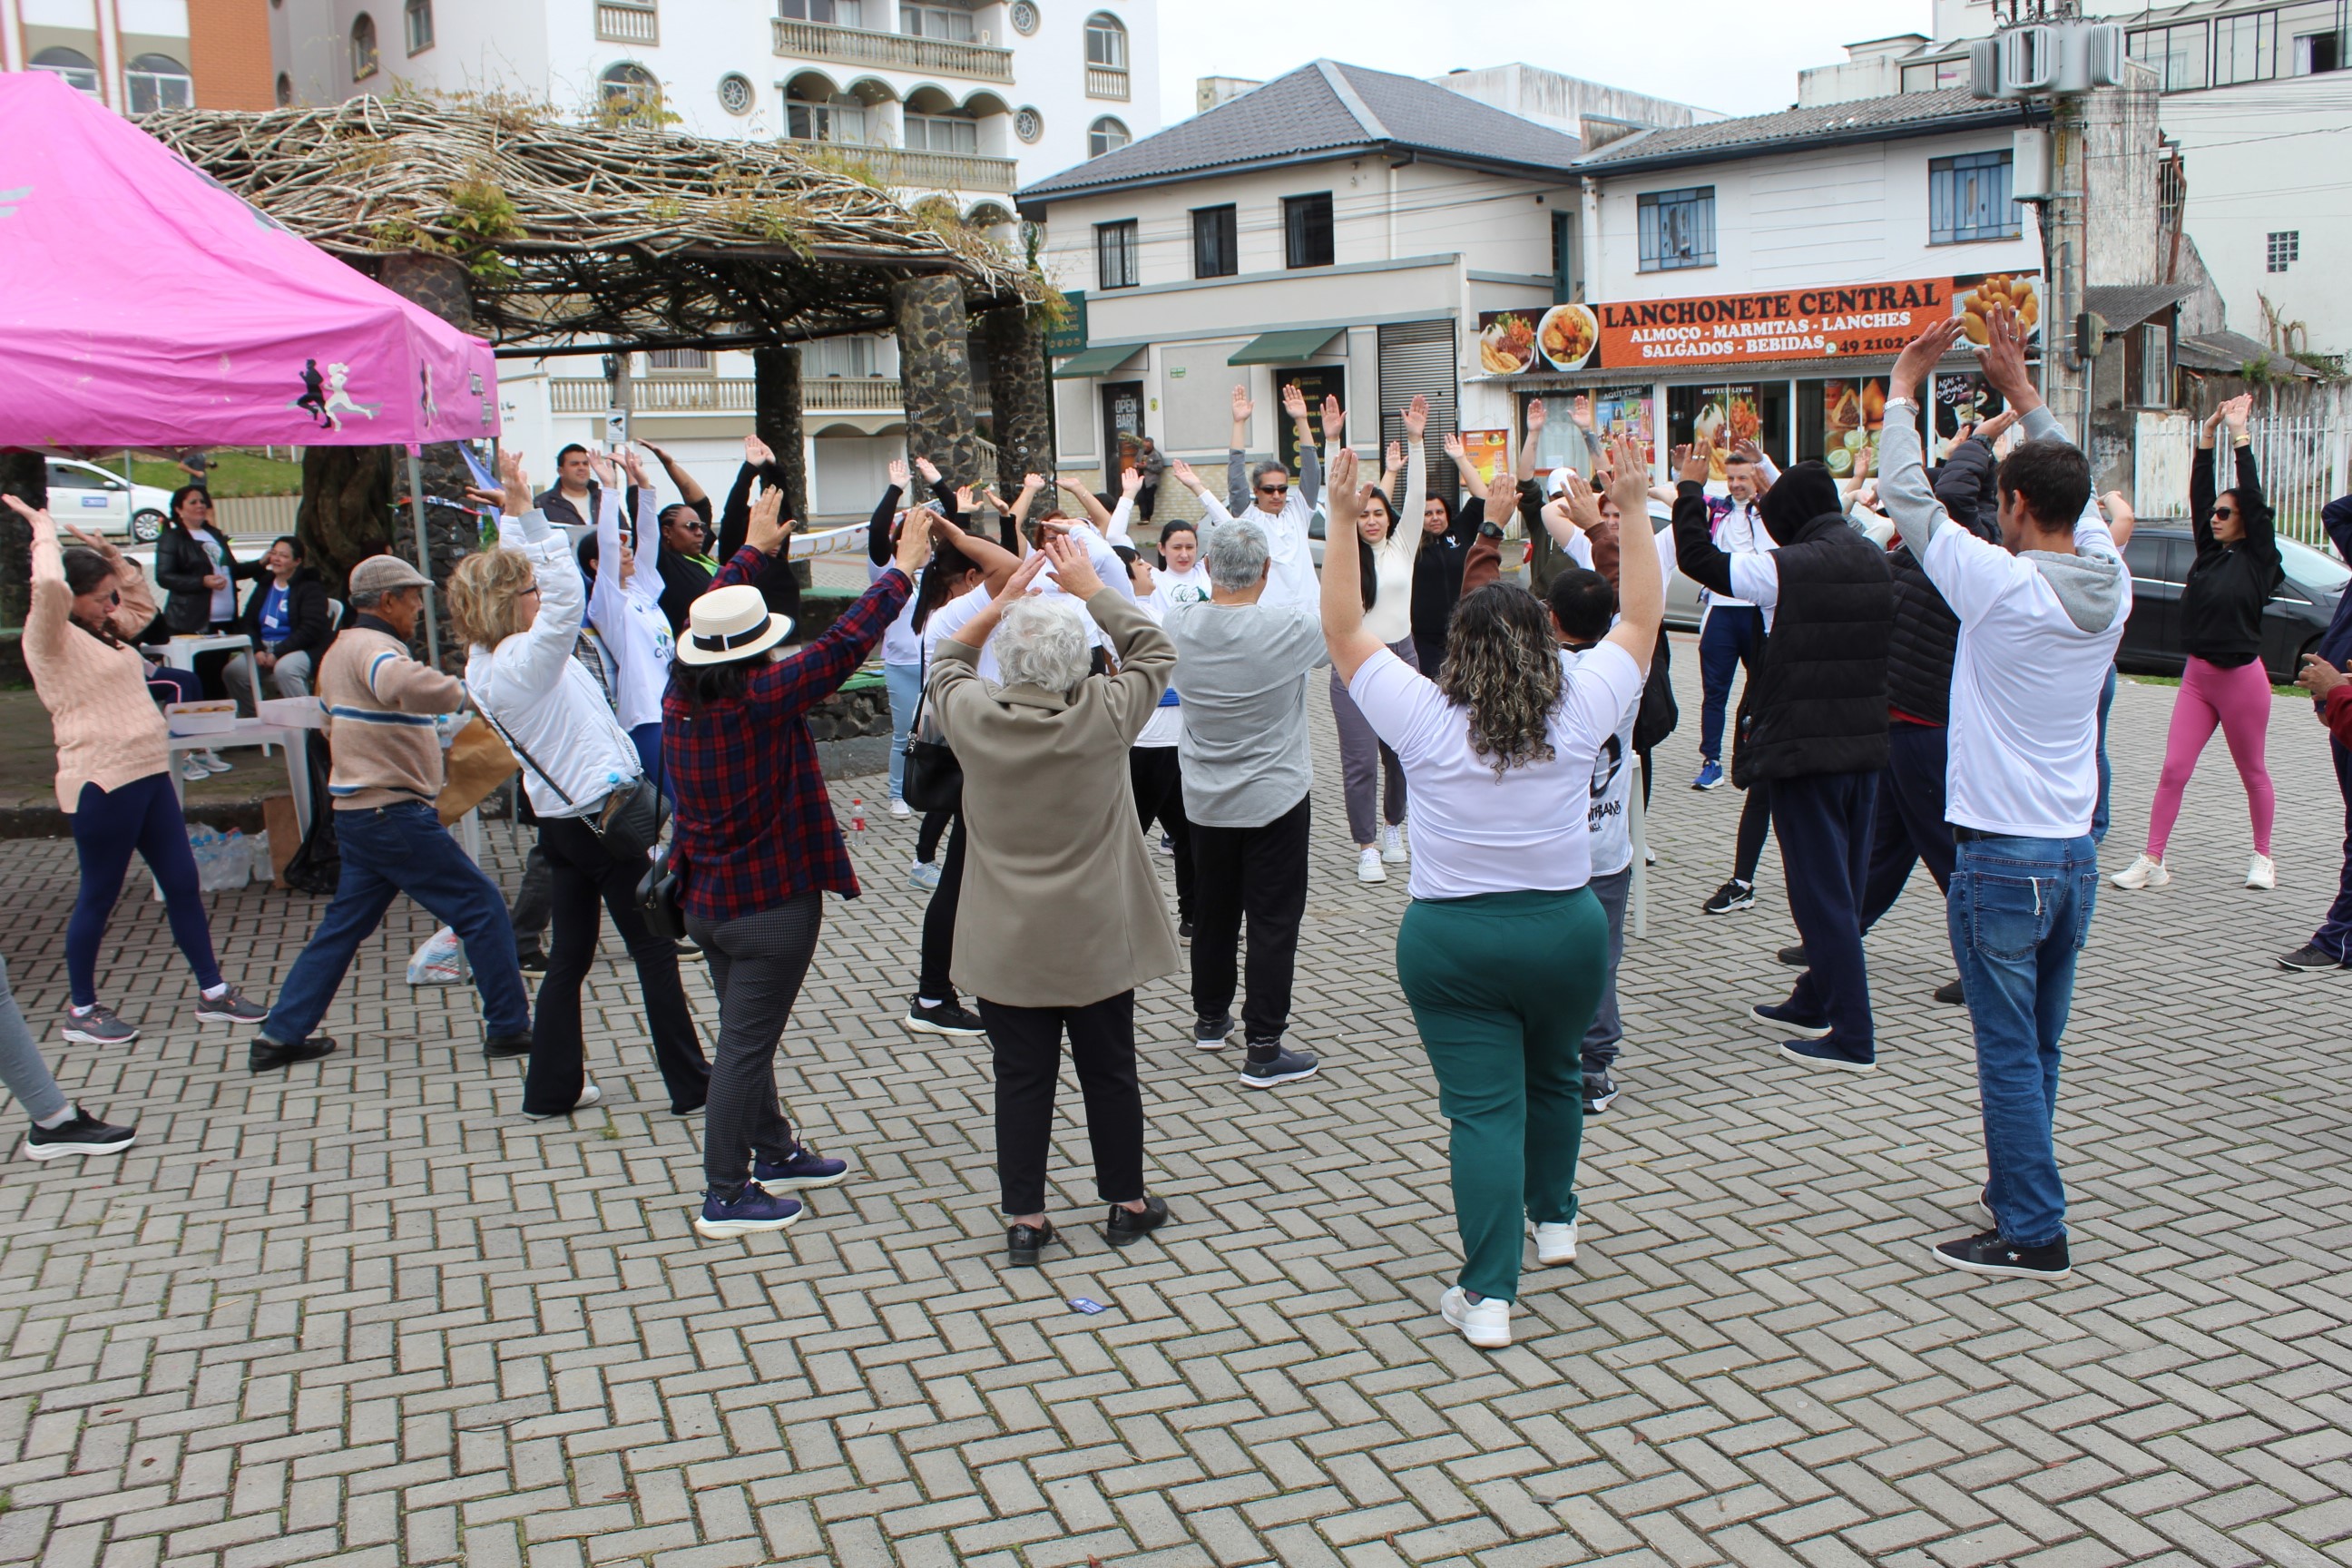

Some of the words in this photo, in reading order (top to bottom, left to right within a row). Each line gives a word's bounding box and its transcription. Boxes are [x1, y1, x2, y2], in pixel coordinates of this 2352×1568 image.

[1604, 294, 1791, 328] LANCHONETE
[1798, 283, 1941, 316] CENTRAL
[1630, 326, 1701, 343] ALMOÇO
[1713, 318, 1809, 339] MARMITAS
[1822, 311, 1911, 332] LANCHES
[1642, 340, 1734, 358] SALGADOS
[1746, 335, 1825, 353] BEBIDAS
[1839, 339, 1859, 353] 49
[1603, 390, 1622, 400] AQUI
[1623, 387, 1642, 397] TEM!
[1115, 398, 1137, 414] OPEN
[1116, 413, 1137, 428] BAR?
